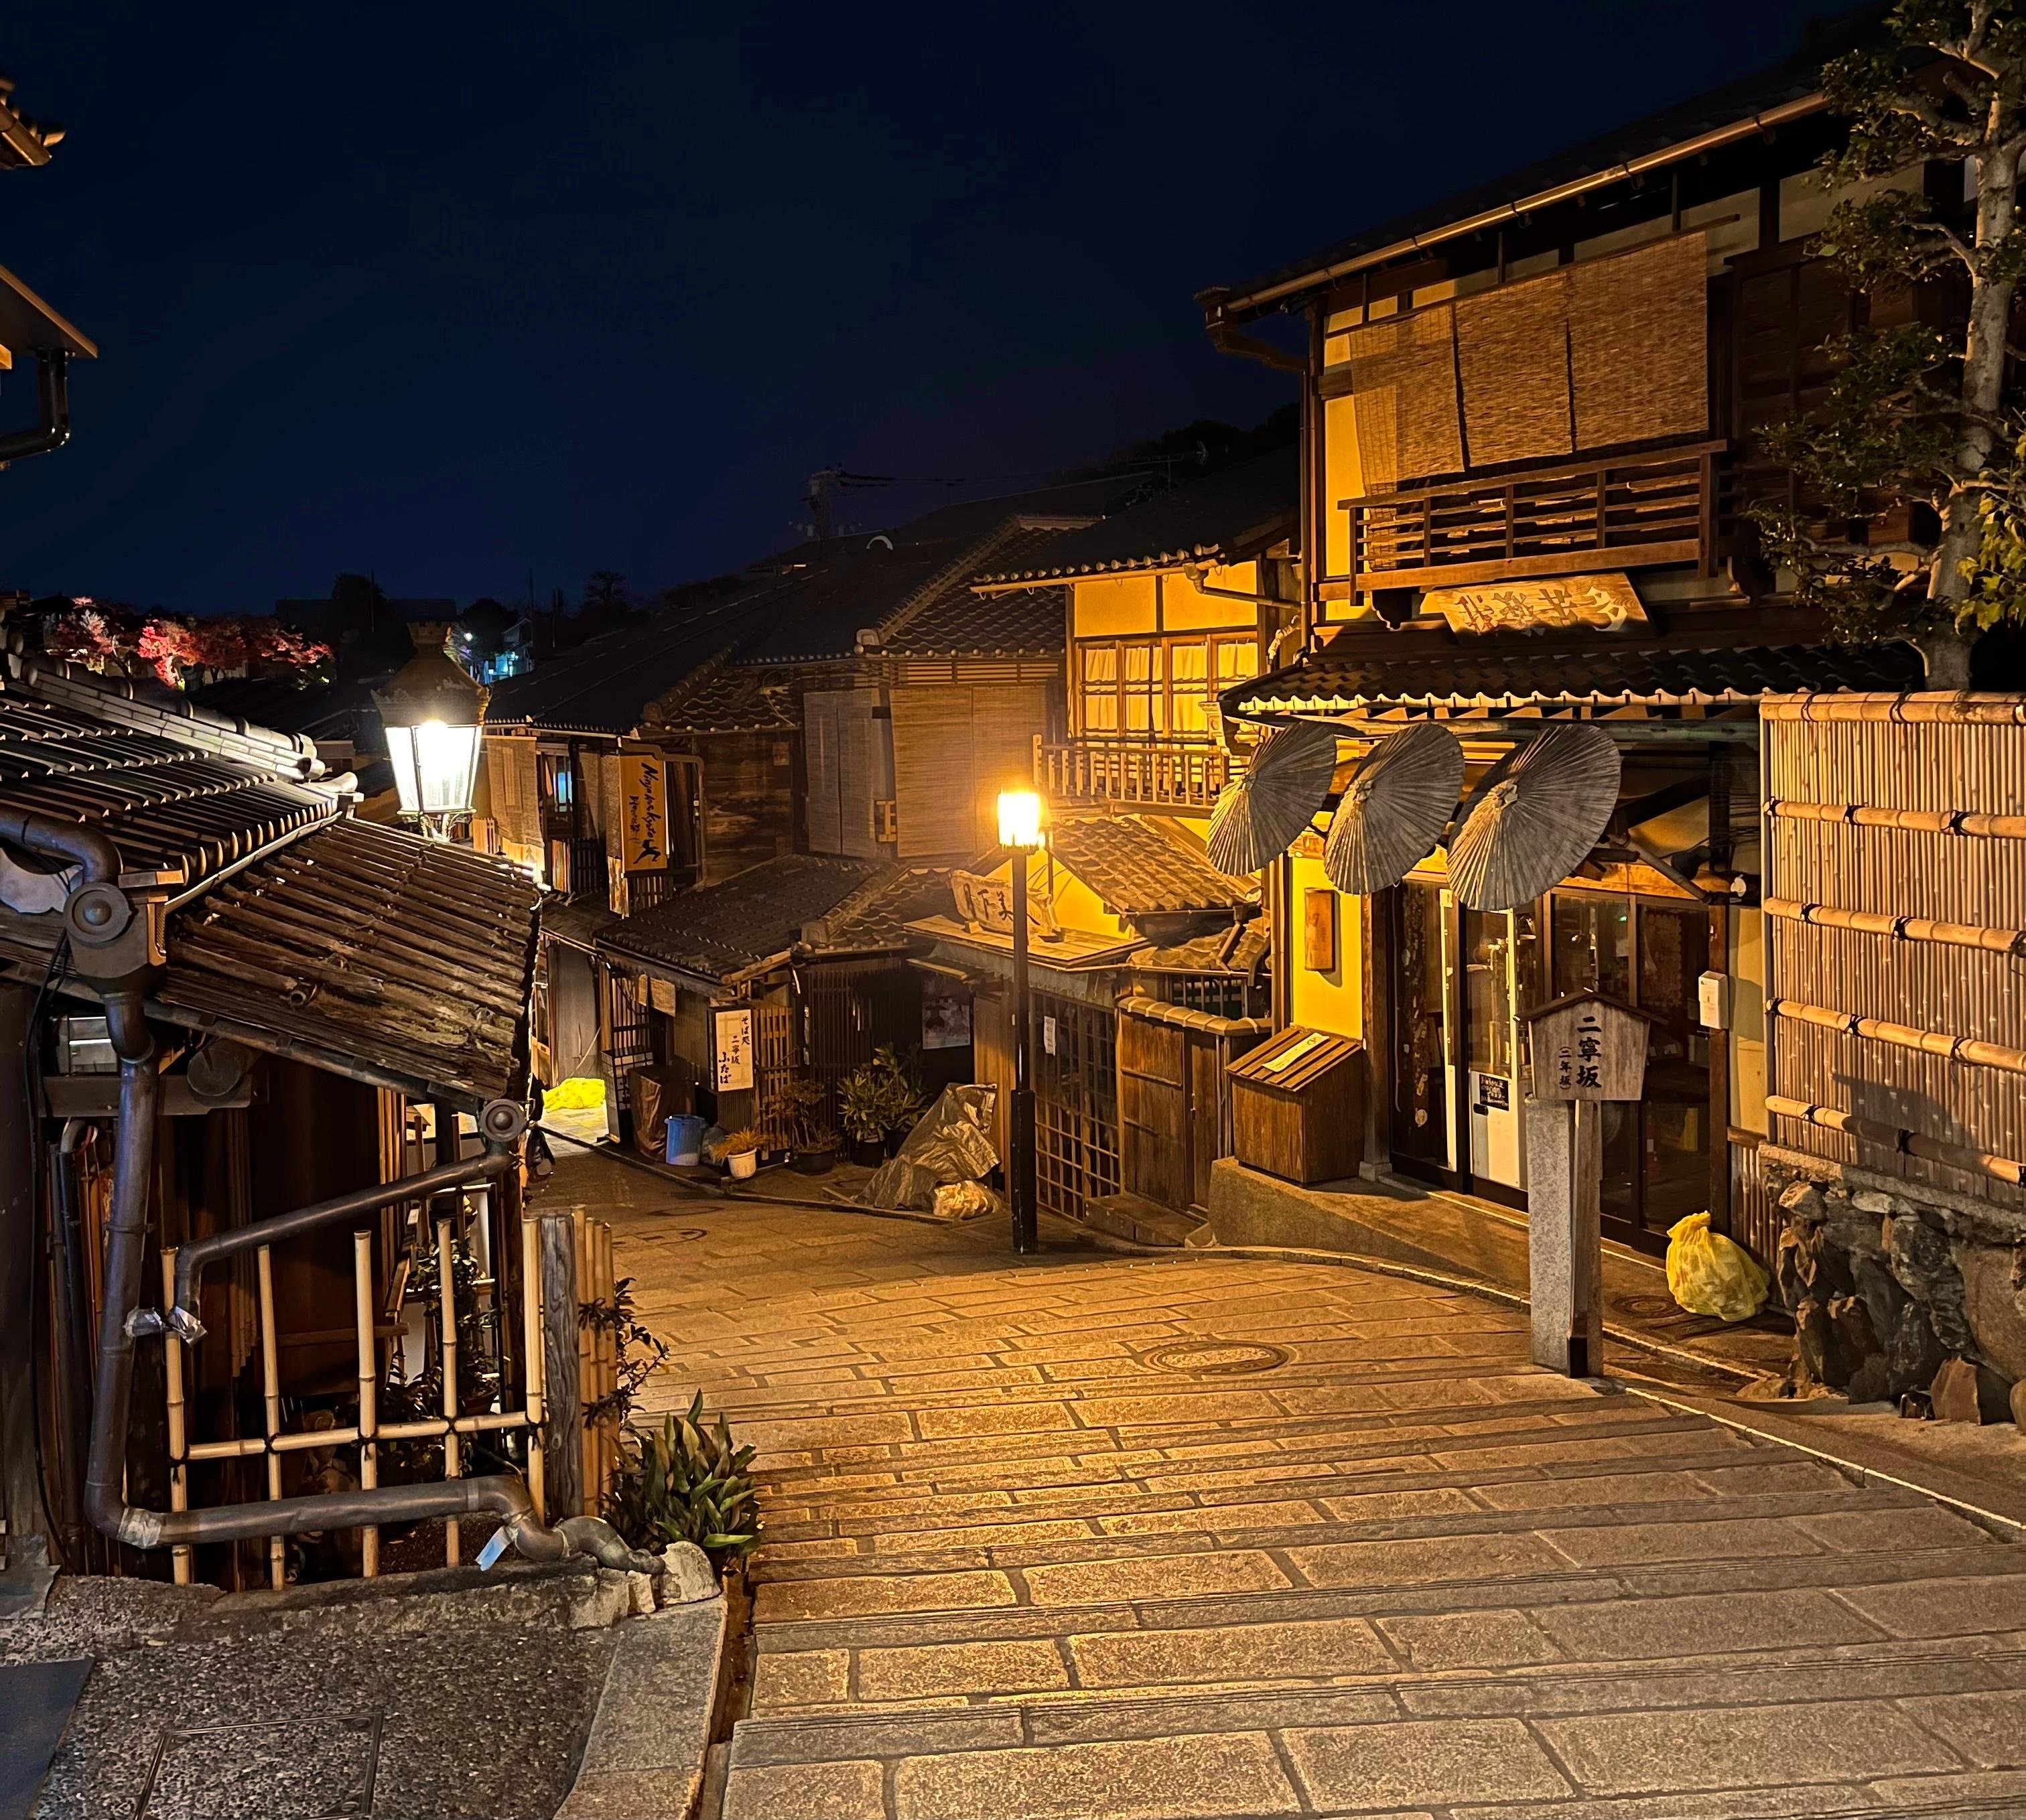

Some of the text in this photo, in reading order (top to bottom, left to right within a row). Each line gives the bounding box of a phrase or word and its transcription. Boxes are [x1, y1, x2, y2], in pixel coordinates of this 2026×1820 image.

[638, 762, 659, 793] Ninja
[741, 1016, 750, 1046] そば処
[718, 1052, 732, 1084] ふたば
[1576, 1016, 1603, 1089] 二寧坂
